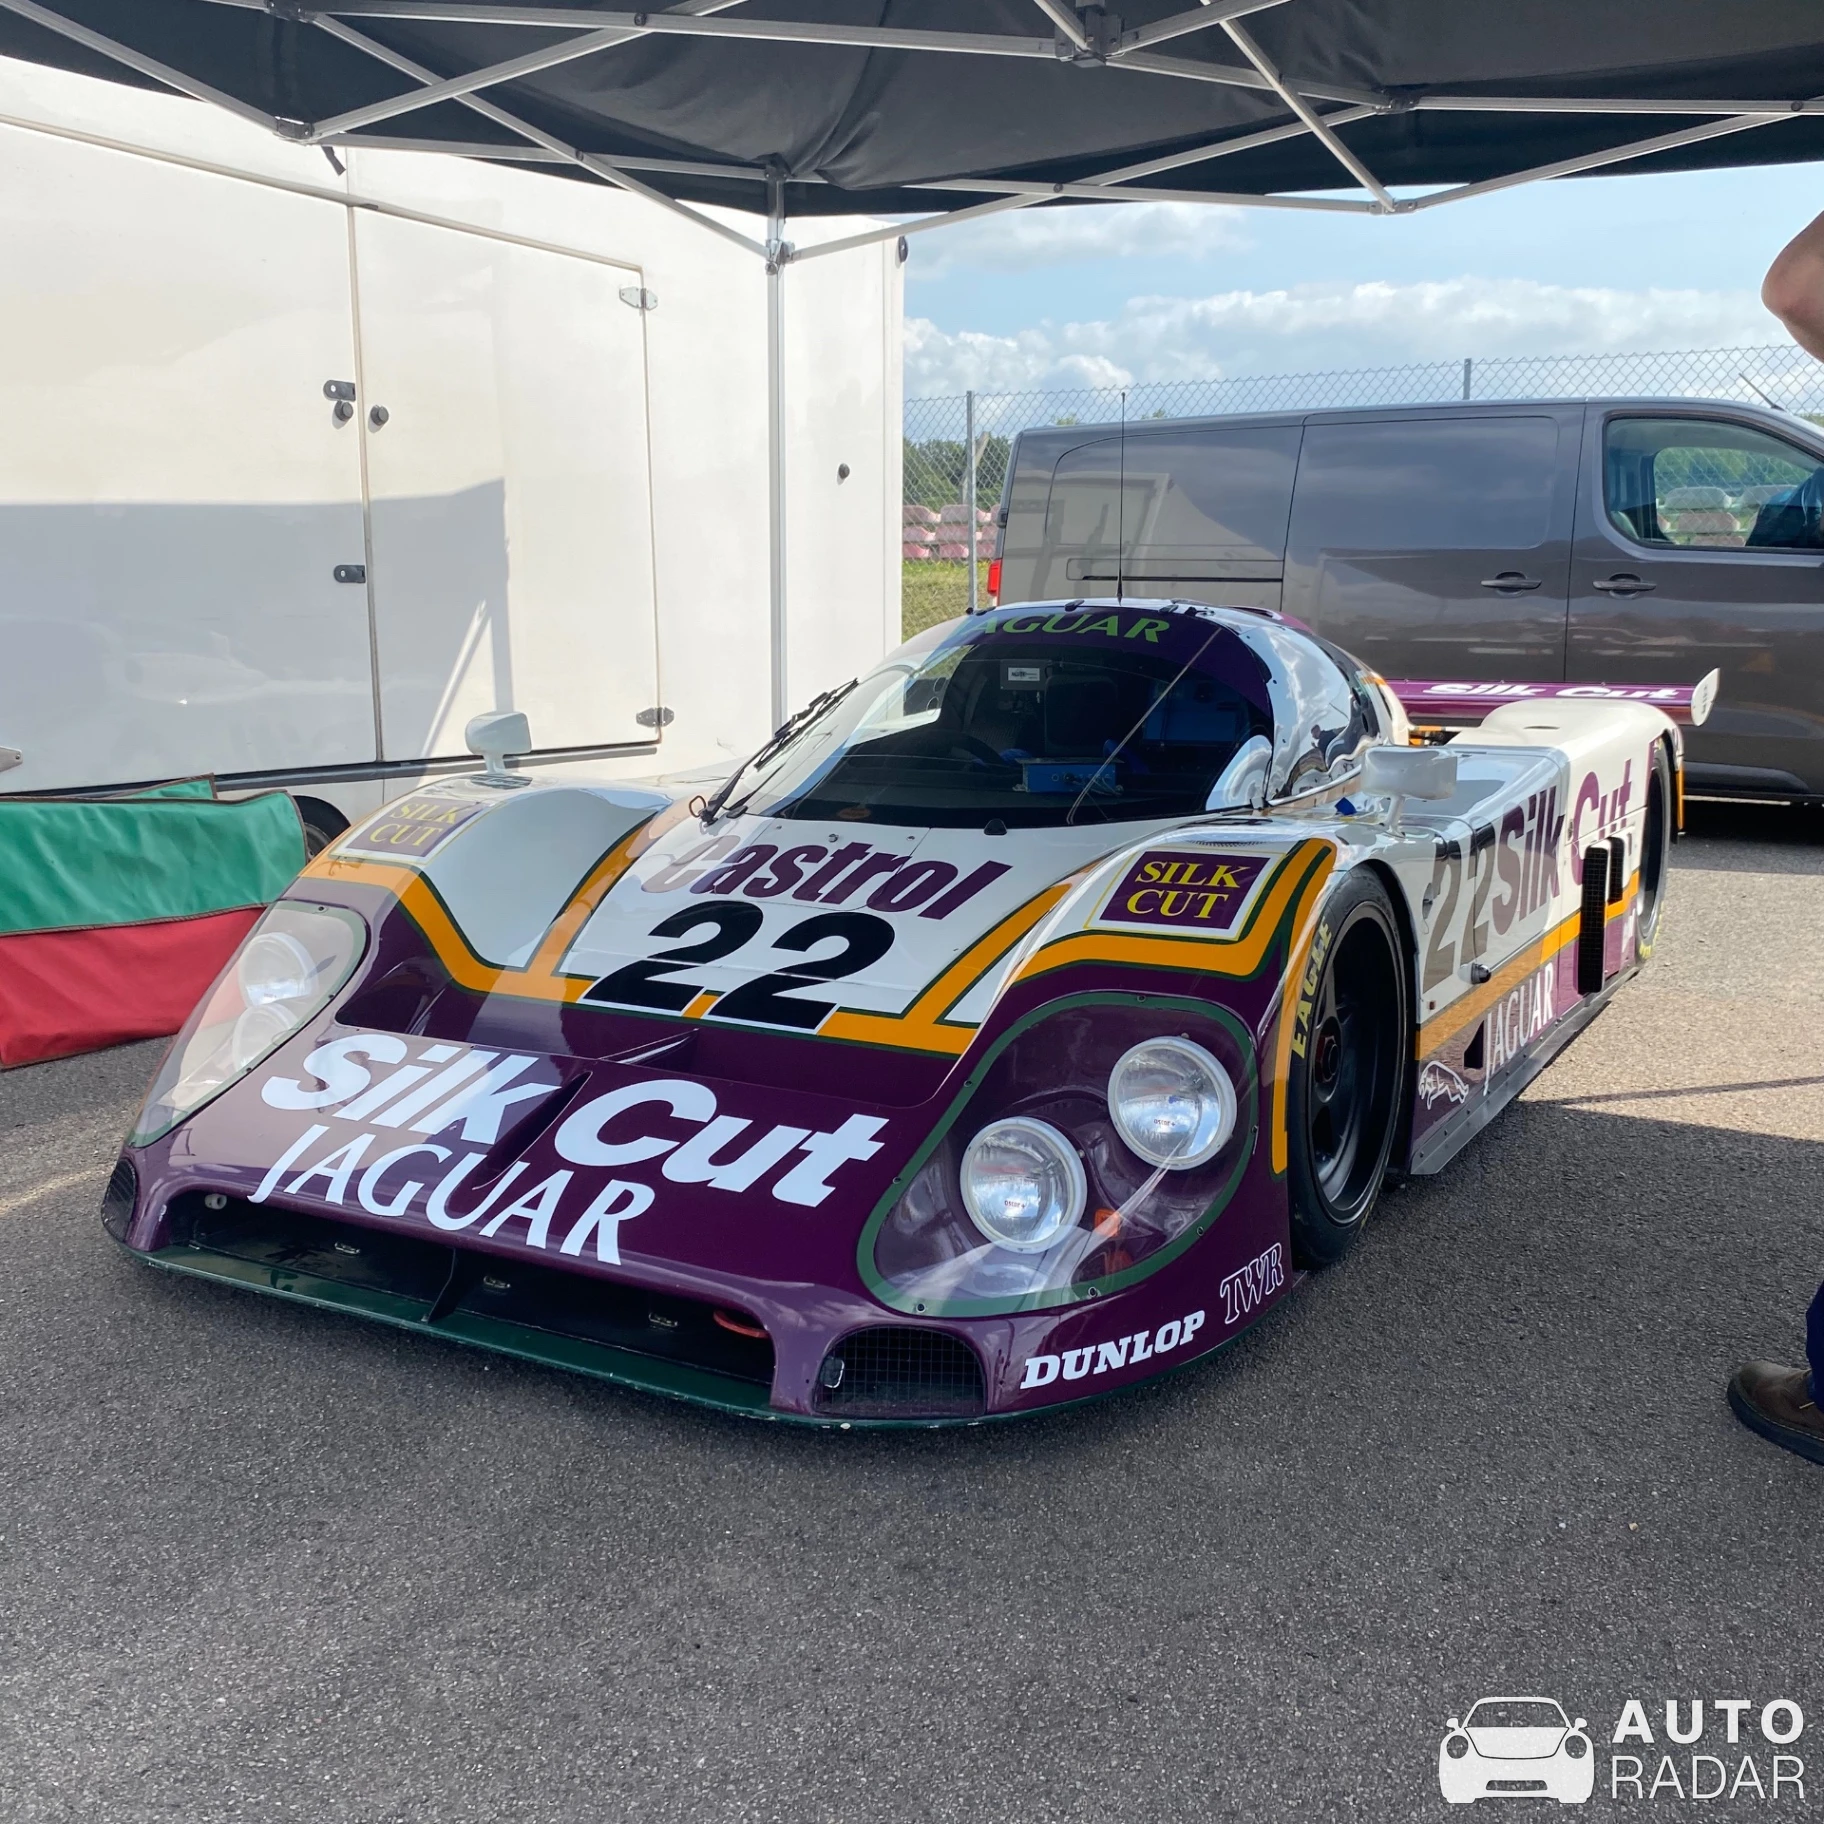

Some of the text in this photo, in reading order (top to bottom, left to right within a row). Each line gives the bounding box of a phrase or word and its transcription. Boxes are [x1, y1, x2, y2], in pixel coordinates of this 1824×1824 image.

[1422, 683, 1679, 699] Silk Cut
[369, 823, 444, 847] CUT
[391, 802, 461, 825] SILK
[640, 834, 1013, 920] Castrol
[1135, 860, 1251, 888] SILK
[1492, 785, 1566, 936] Silk
[1126, 888, 1229, 919] CUT
[581, 899, 896, 1032] 22
[1292, 916, 1332, 1059] EAGLE
[1483, 962, 1555, 1097] JAGUAR
[261, 1033, 890, 1208] Silk Cut
[247, 1124, 656, 1266] JAGUAR
[1220, 1242, 1284, 1325] TWR
[1019, 1310, 1206, 1389] DUNLOP
